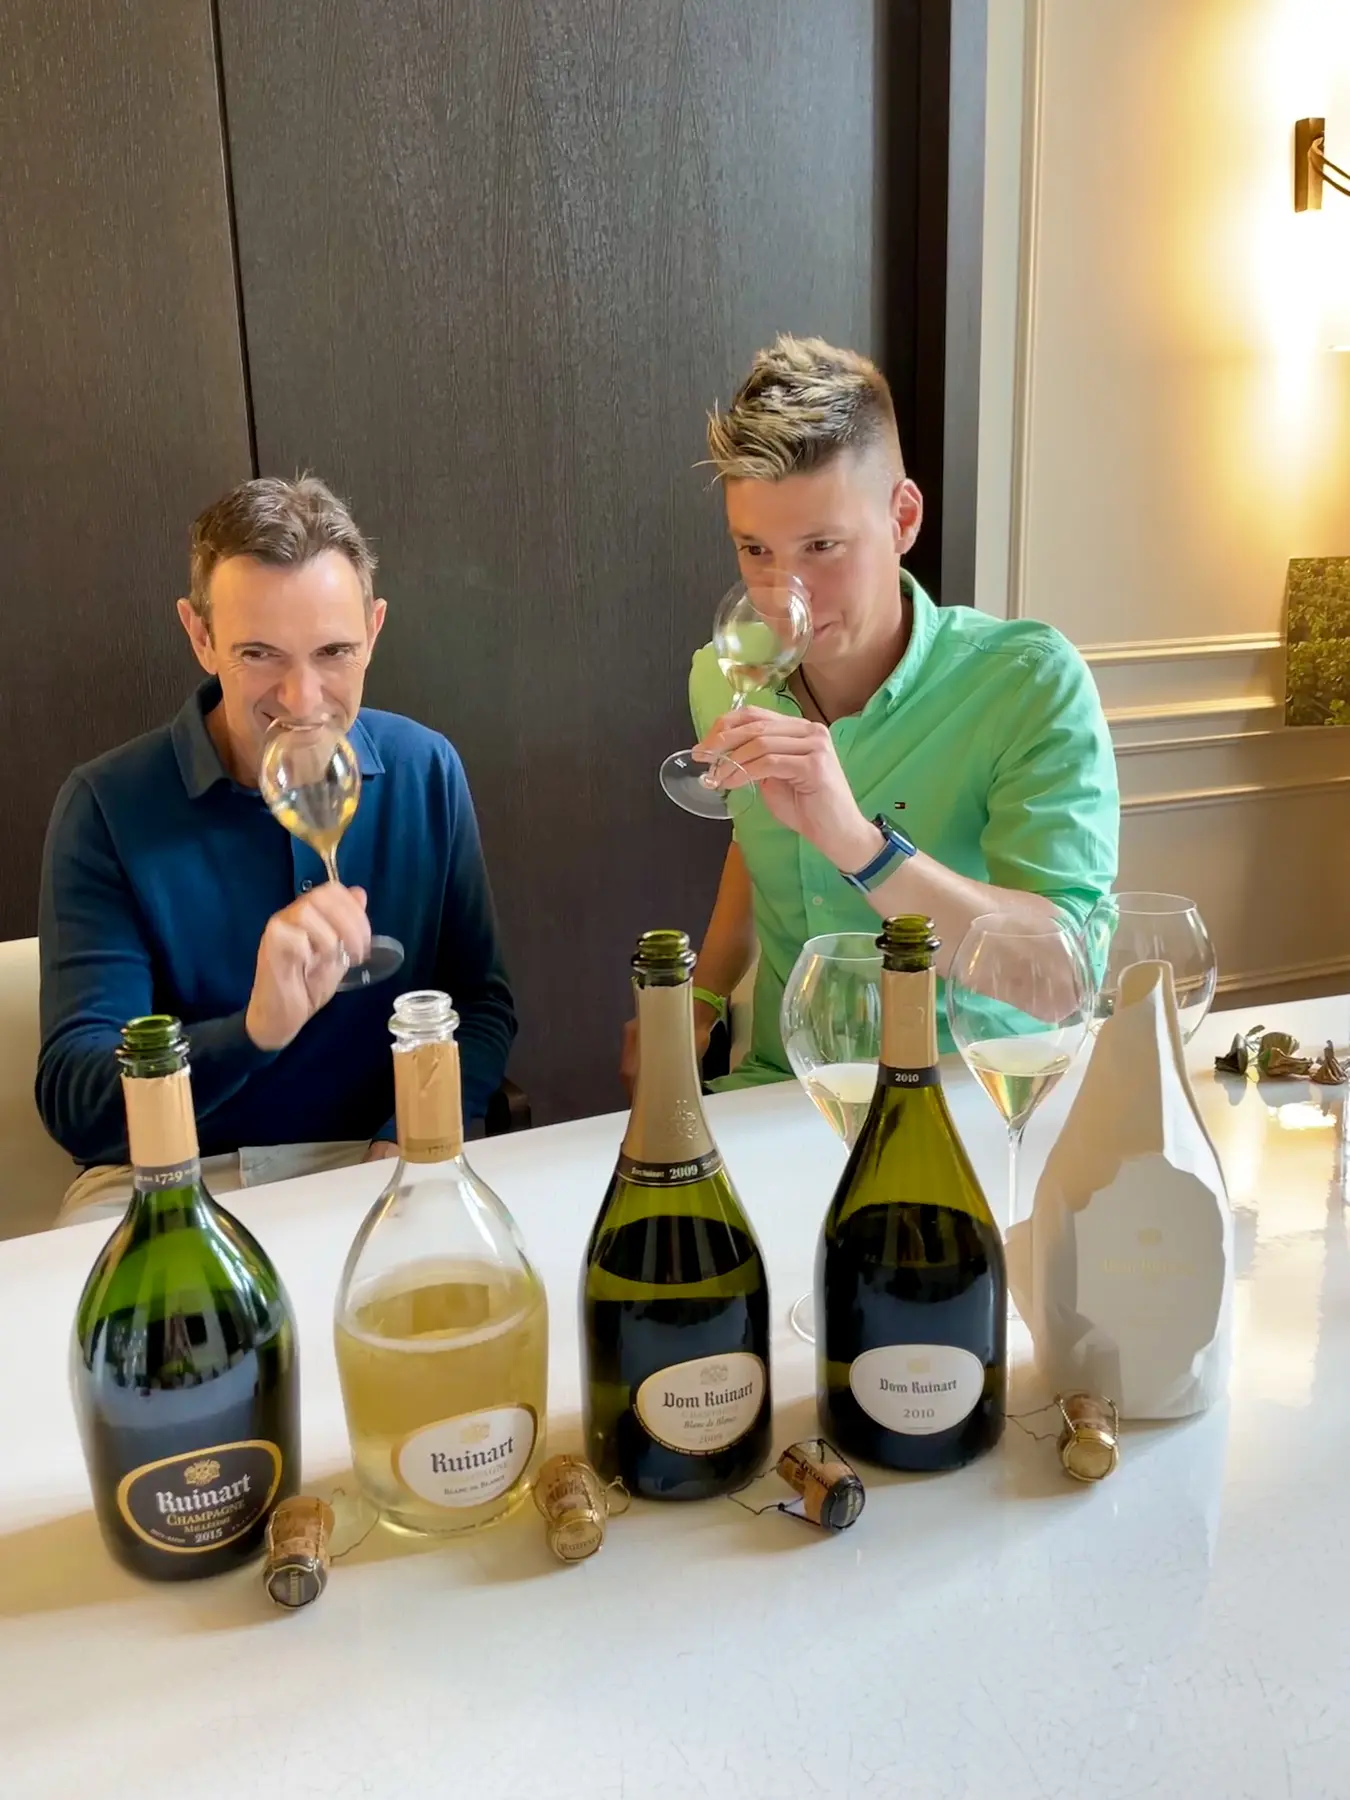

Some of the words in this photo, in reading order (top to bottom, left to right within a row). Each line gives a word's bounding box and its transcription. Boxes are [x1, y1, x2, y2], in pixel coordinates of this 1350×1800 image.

[894, 1072, 920, 1083] 2010
[154, 1170, 184, 1186] 1729
[669, 1164, 699, 1180] 2009
[879, 1377, 909, 1394] Dom
[911, 1379, 958, 1395] Ruinart
[662, 1391, 700, 1409] Dom
[704, 1381, 754, 1408] Ruinart
[902, 1407, 936, 1420] 2010
[430, 1435, 515, 1474] Ruinart
[155, 1473, 252, 1515] Ruinart
[165, 1499, 246, 1527] CHAMPAGNE
[194, 1527, 224, 1544] 2015
